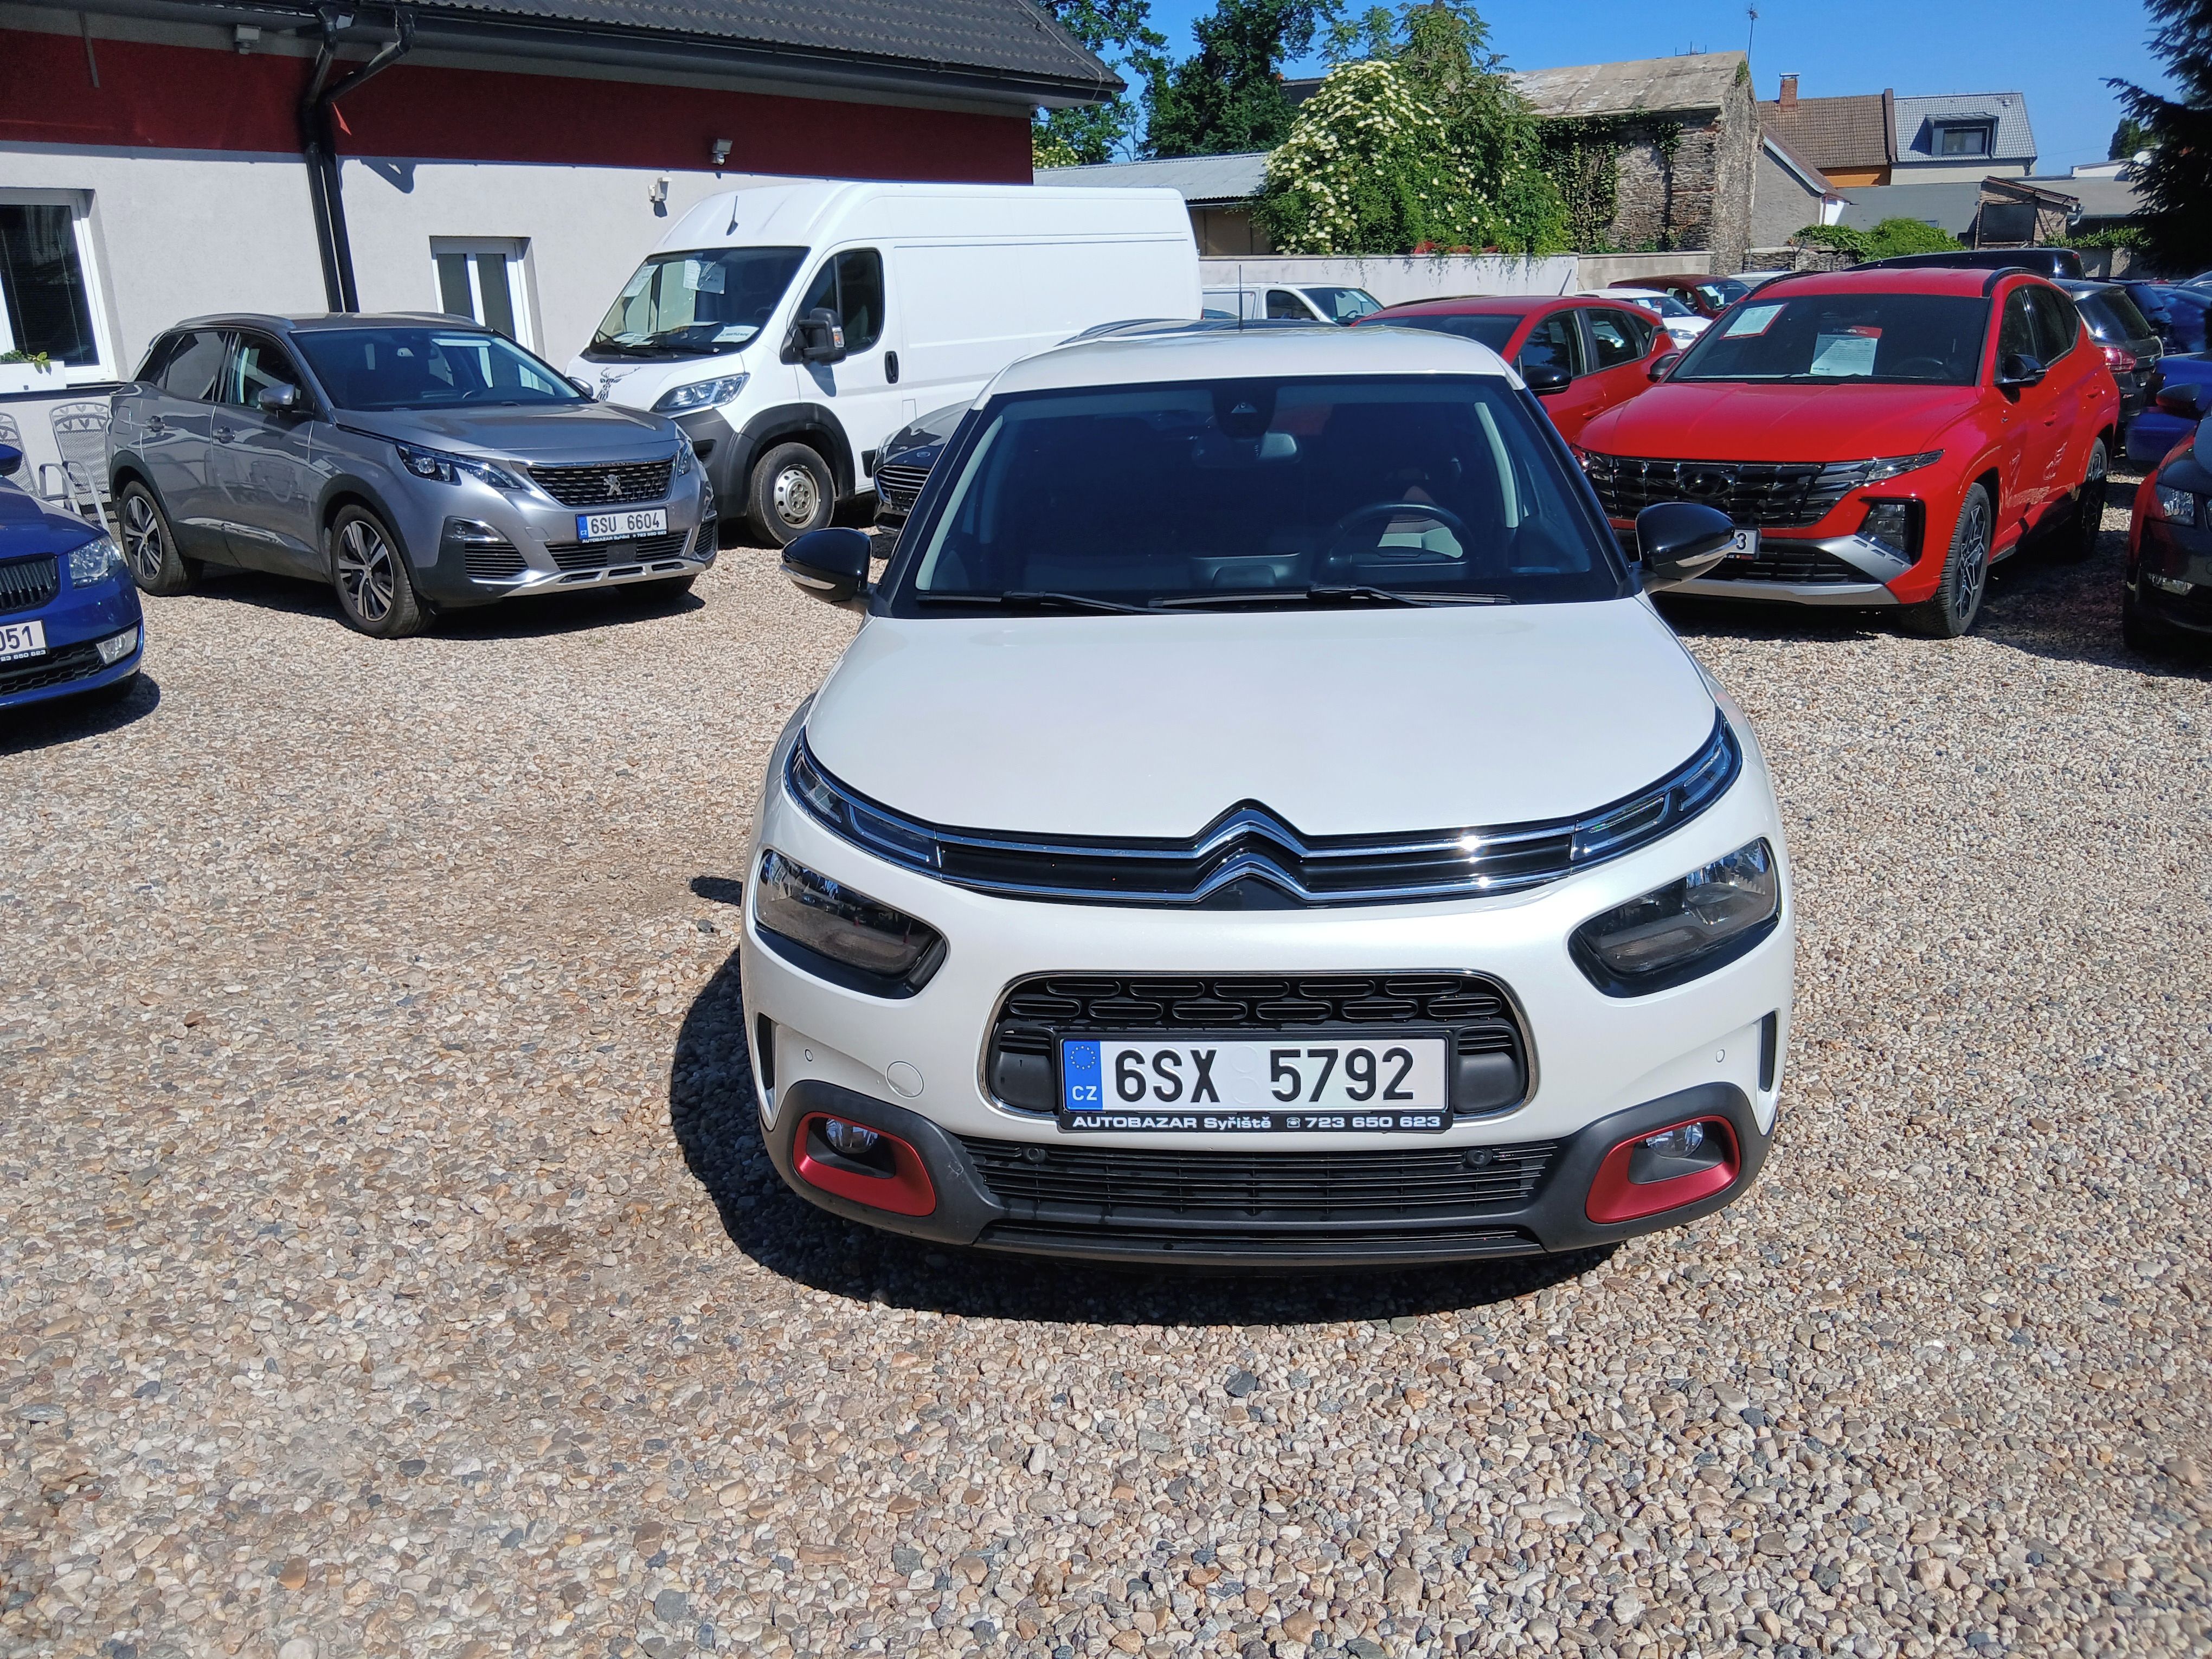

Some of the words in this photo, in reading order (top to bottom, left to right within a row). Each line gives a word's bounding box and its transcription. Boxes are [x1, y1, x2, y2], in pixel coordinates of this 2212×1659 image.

[591, 516, 616, 534] 6SU
[627, 512, 659, 530] 6604
[1737, 532, 1747, 550] 3
[1115, 1049, 1221, 1103] 6SX
[1269, 1047, 1414, 1103] 5792
[1071, 1085, 1098, 1101] CZ
[1072, 1116, 1197, 1128] AUTOBAZAR
[1204, 1116, 1271, 1130] Syřiště
[1304, 1117, 1346, 1128] 723
[1352, 1116, 1393, 1128] 650
[1399, 1116, 1441, 1127] 623
